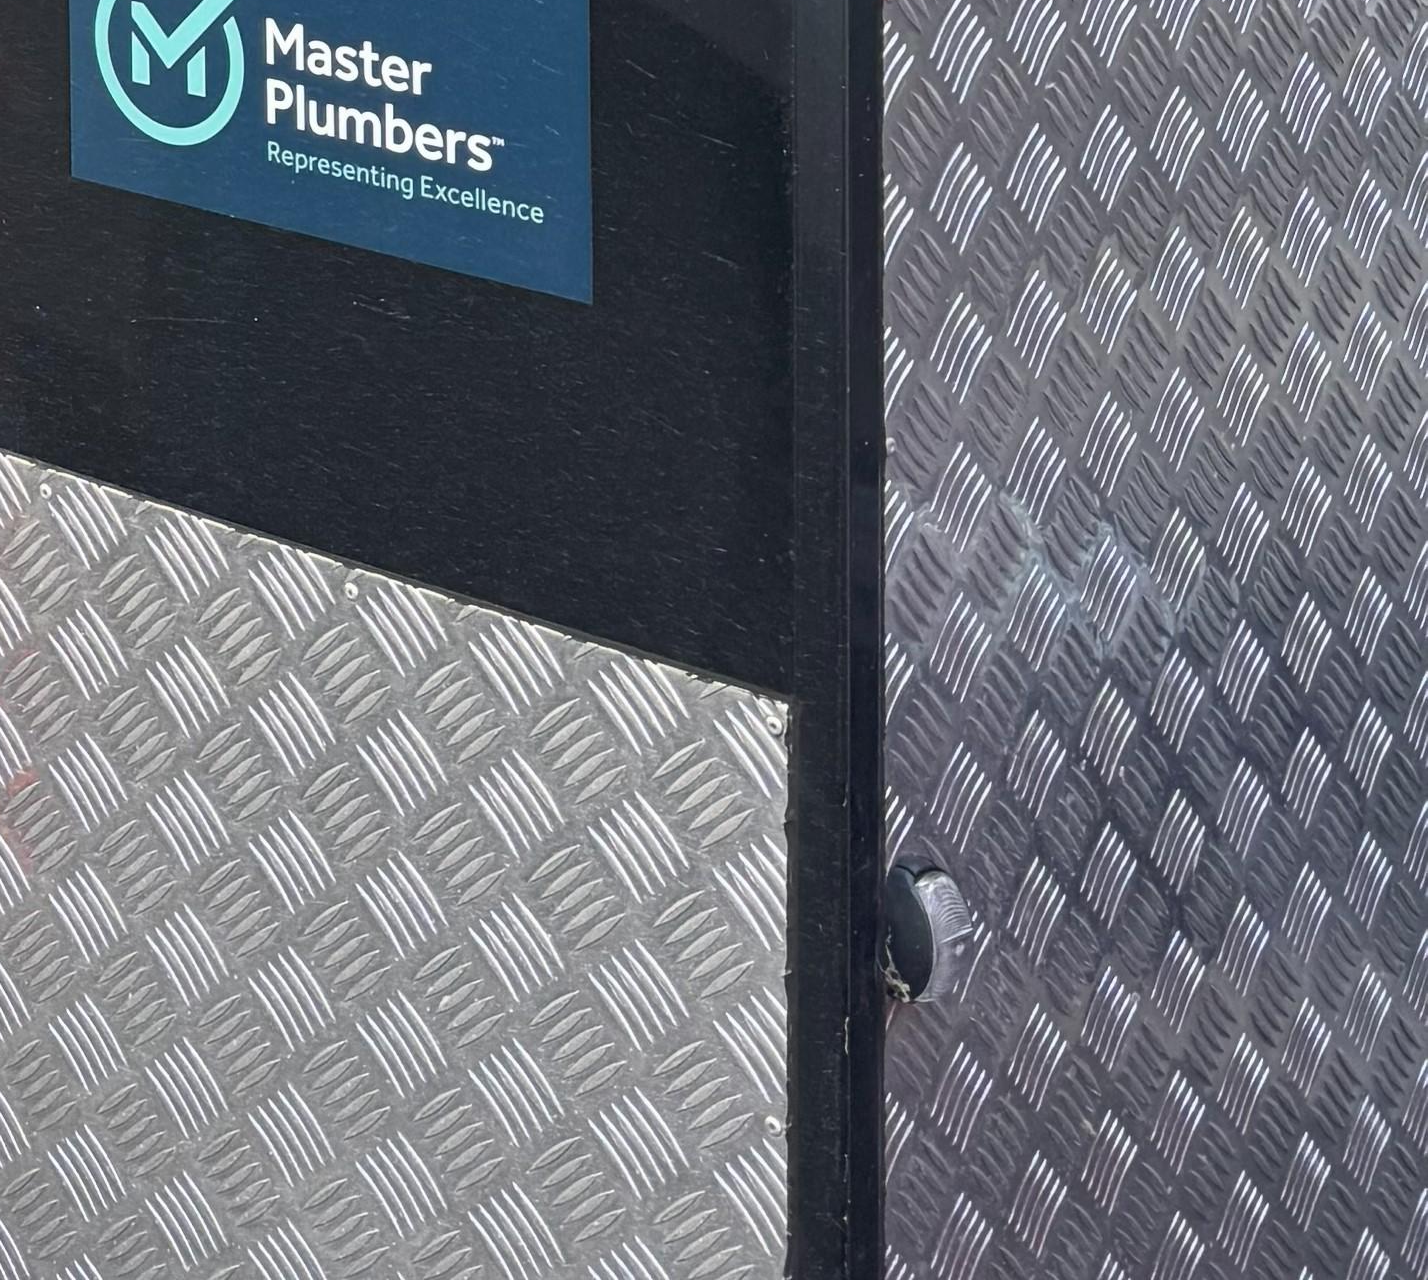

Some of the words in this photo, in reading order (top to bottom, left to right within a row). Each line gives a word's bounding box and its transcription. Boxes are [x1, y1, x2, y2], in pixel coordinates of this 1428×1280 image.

[265, 17, 433, 96] Master
[267, 140, 414, 200] Representing
[420, 174, 545, 224] Excellence
